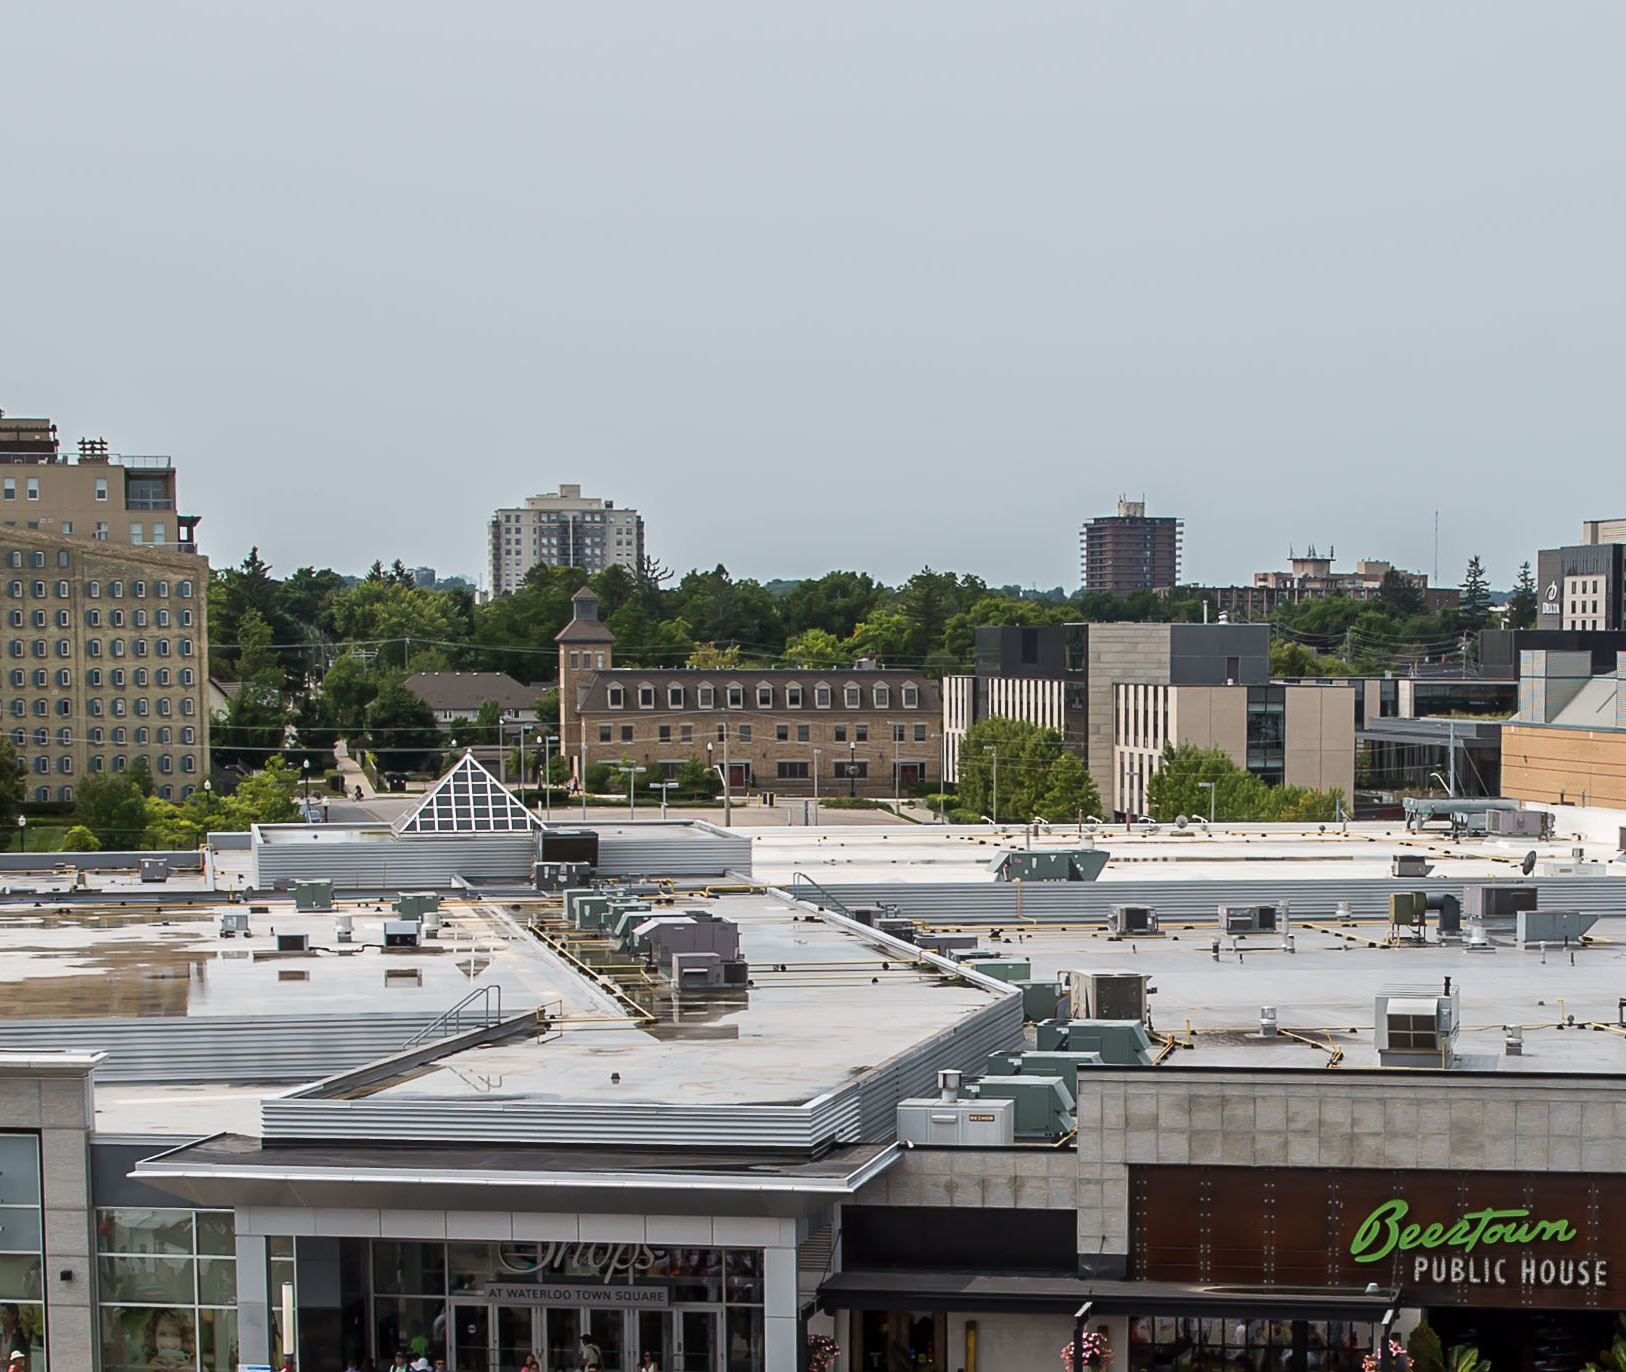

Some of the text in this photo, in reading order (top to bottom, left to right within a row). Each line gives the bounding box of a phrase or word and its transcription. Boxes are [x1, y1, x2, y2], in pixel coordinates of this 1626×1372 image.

[1413, 1255, 1608, 1288] PUBLIC HOUSE
[489, 1289, 664, 1302] AT WATERLOO TOWN SQUARE
